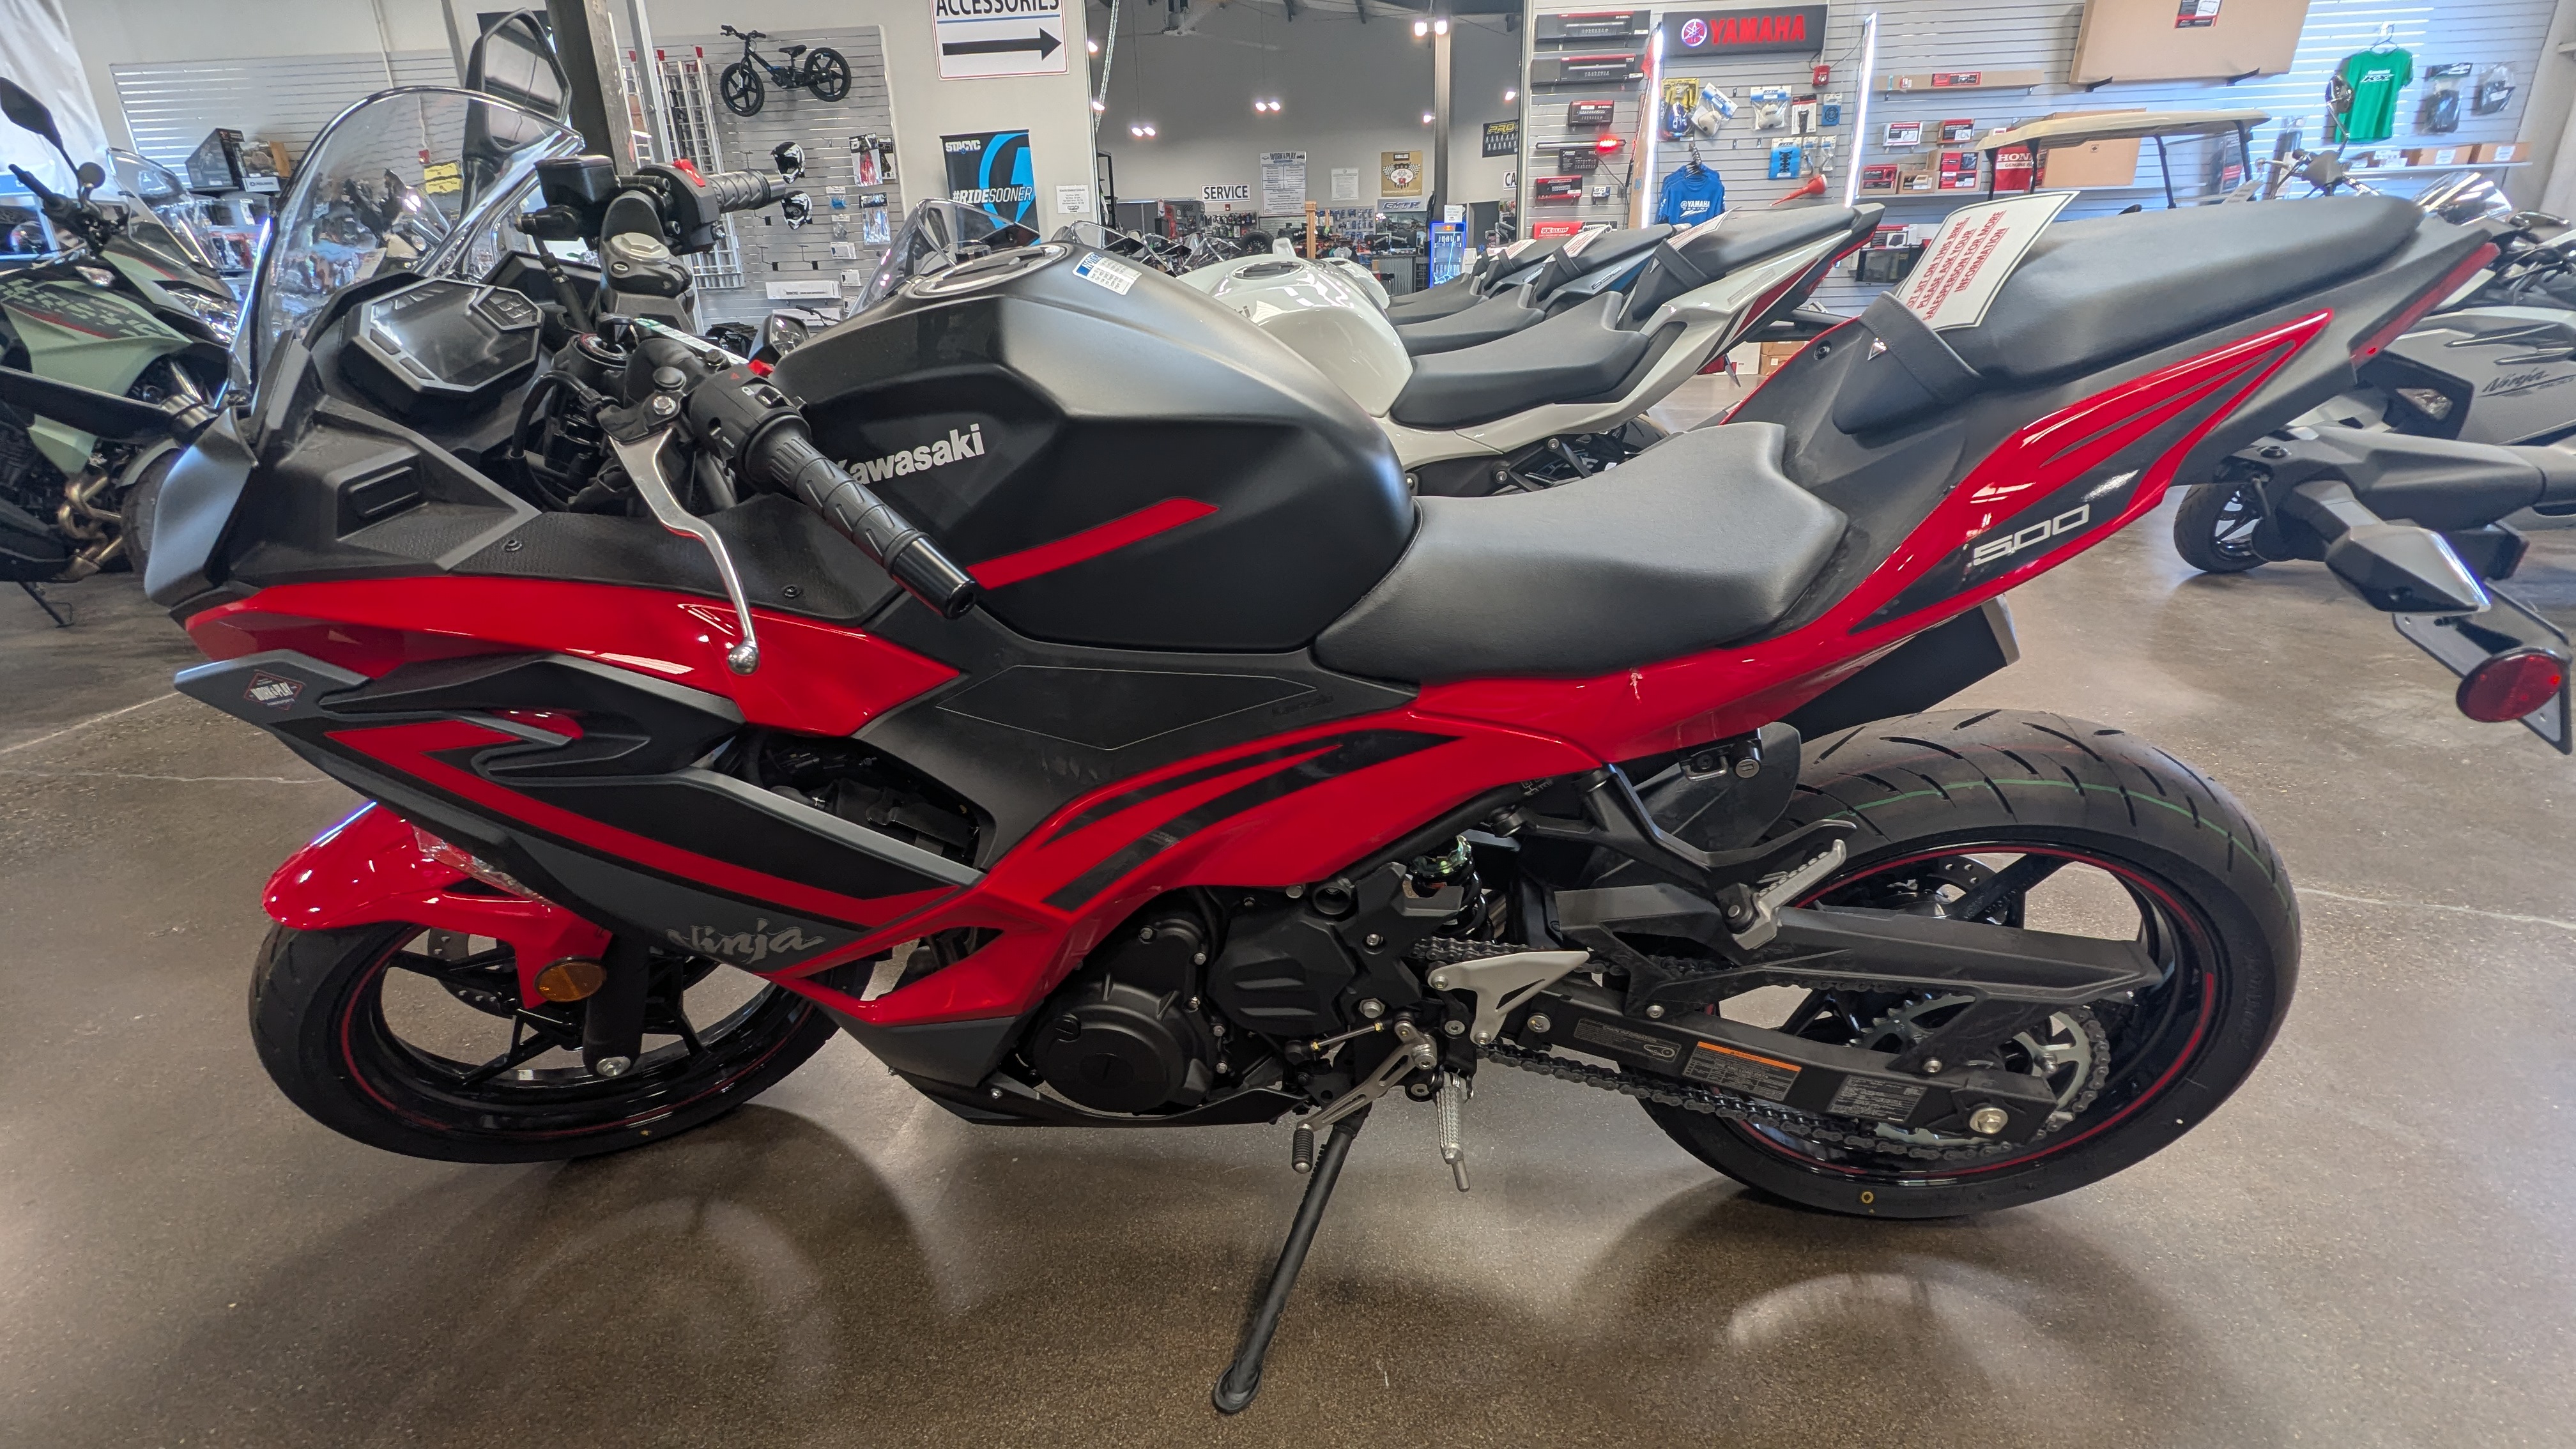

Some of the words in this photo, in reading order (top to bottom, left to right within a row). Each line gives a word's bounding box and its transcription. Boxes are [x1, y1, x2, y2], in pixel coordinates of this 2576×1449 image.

[937, 0, 1059, 16] ACCESSORIES
[1710, 14, 1805, 45] YAMAHA
[946, 140, 981, 153] STACYC
[1997, 153, 2033, 162] HON
[1204, 185, 1248, 199] SERVICE
[1505, 172, 1517, 186] CA
[953, 187, 1032, 204] #RIDESOONER
[1383, 201, 1421, 210] GYTR
[1687, 200, 1710, 208] YAMAHA
[1917, 277, 1943, 309] PLEASE
[1939, 256, 1956, 273] ASK
[1950, 230, 1973, 256] YOUR
[1922, 257, 1970, 320] SALESPERSON
[1964, 238, 1982, 256] FOR
[1977, 211, 2004, 236] MORE
[1954, 228, 2006, 292] INFORMATION
[1906, 295, 1918, 307] OT
[1913, 280, 1928, 293] SIT
[1923, 262, 1938, 277] ON
[1933, 241, 1952, 262] THIS
[2482, 367, 2550, 393] Ninja
[836, 423, 985, 485] awasaki
[1973, 503, 2090, 565] 500
[665, 917, 826, 965] Ninja
